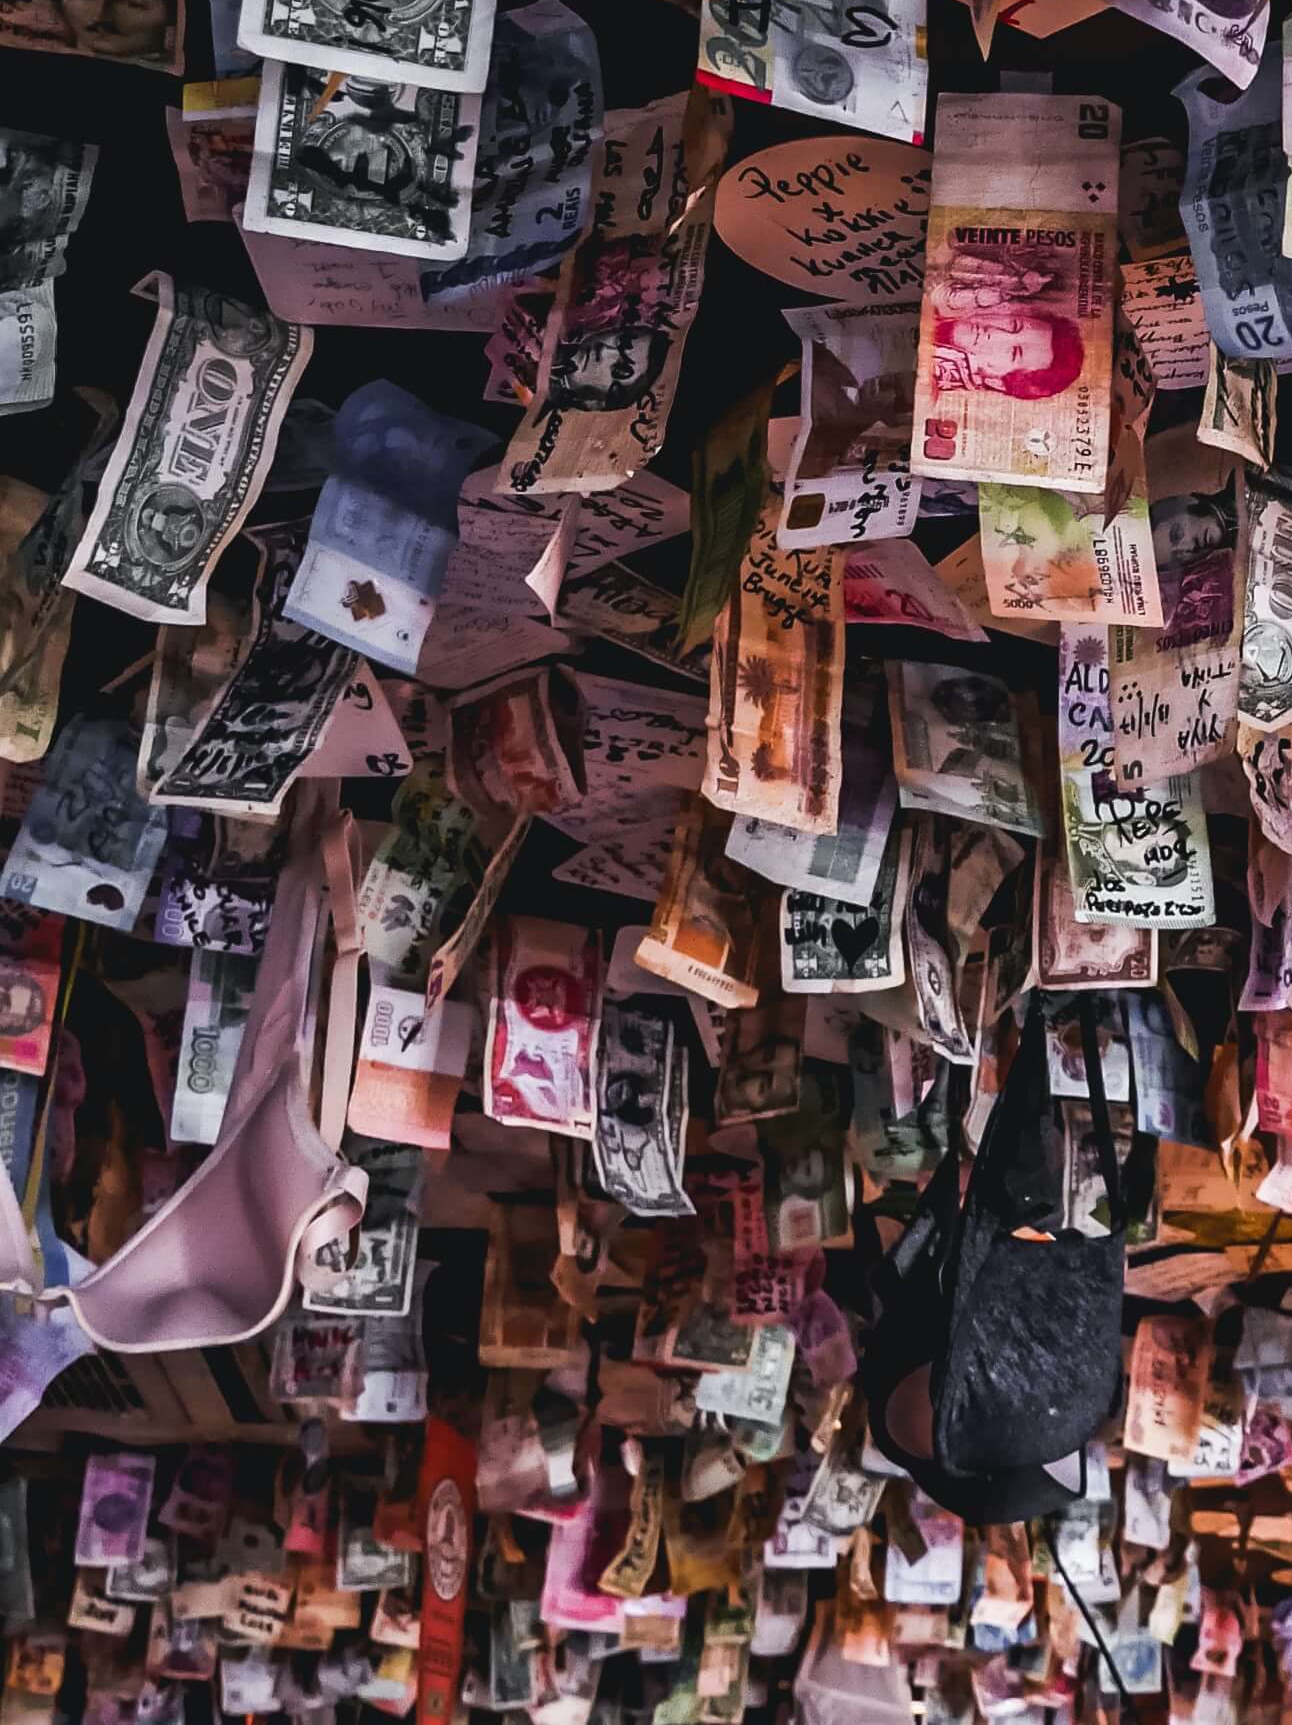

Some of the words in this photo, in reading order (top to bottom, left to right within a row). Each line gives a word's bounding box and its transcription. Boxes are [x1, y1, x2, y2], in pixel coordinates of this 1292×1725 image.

[1078, 104, 1109, 140] 20
[740, 150, 870, 200] Peppie
[535, 197, 563, 225] 2
[563, 186, 582, 231] REAIS
[955, 226, 1021, 244] VEINTE
[1026, 230, 1078, 247] PESOS
[1232, 300, 1270, 315] Pesos
[1234, 315, 1283, 351] 20
[176, 359, 238, 477] ONE
[1003, 598, 1035, 610] 5000
[1122, 760, 1143, 780] 5
[371, 1002, 393, 1045] 1000
[190, 1026, 220, 1094] 1000
